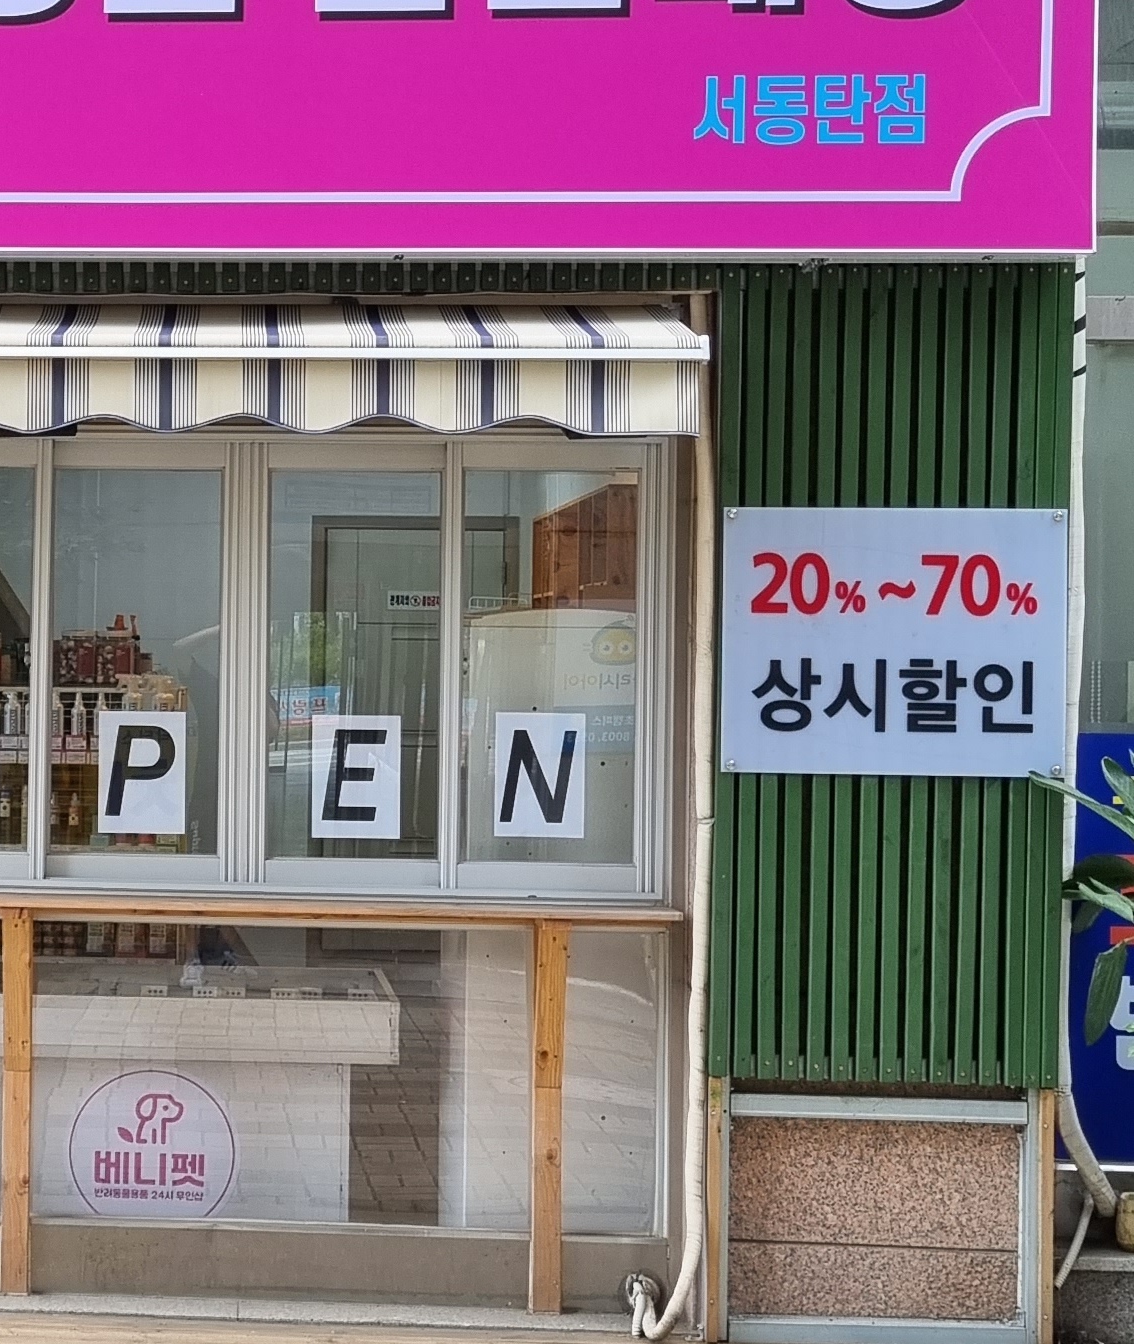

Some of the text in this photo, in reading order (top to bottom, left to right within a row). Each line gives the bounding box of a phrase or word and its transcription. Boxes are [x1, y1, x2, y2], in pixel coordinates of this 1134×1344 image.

[693, 74, 927, 145] 서동탄점
[750, 552, 1038, 617] 20%~70%
[752, 658, 1034, 733] 상시할인
[94, 1151, 204, 1187] 베니펫
[94, 1188, 148, 1199] 반려동물용품
[151, 1191, 173, 1200] 24시
